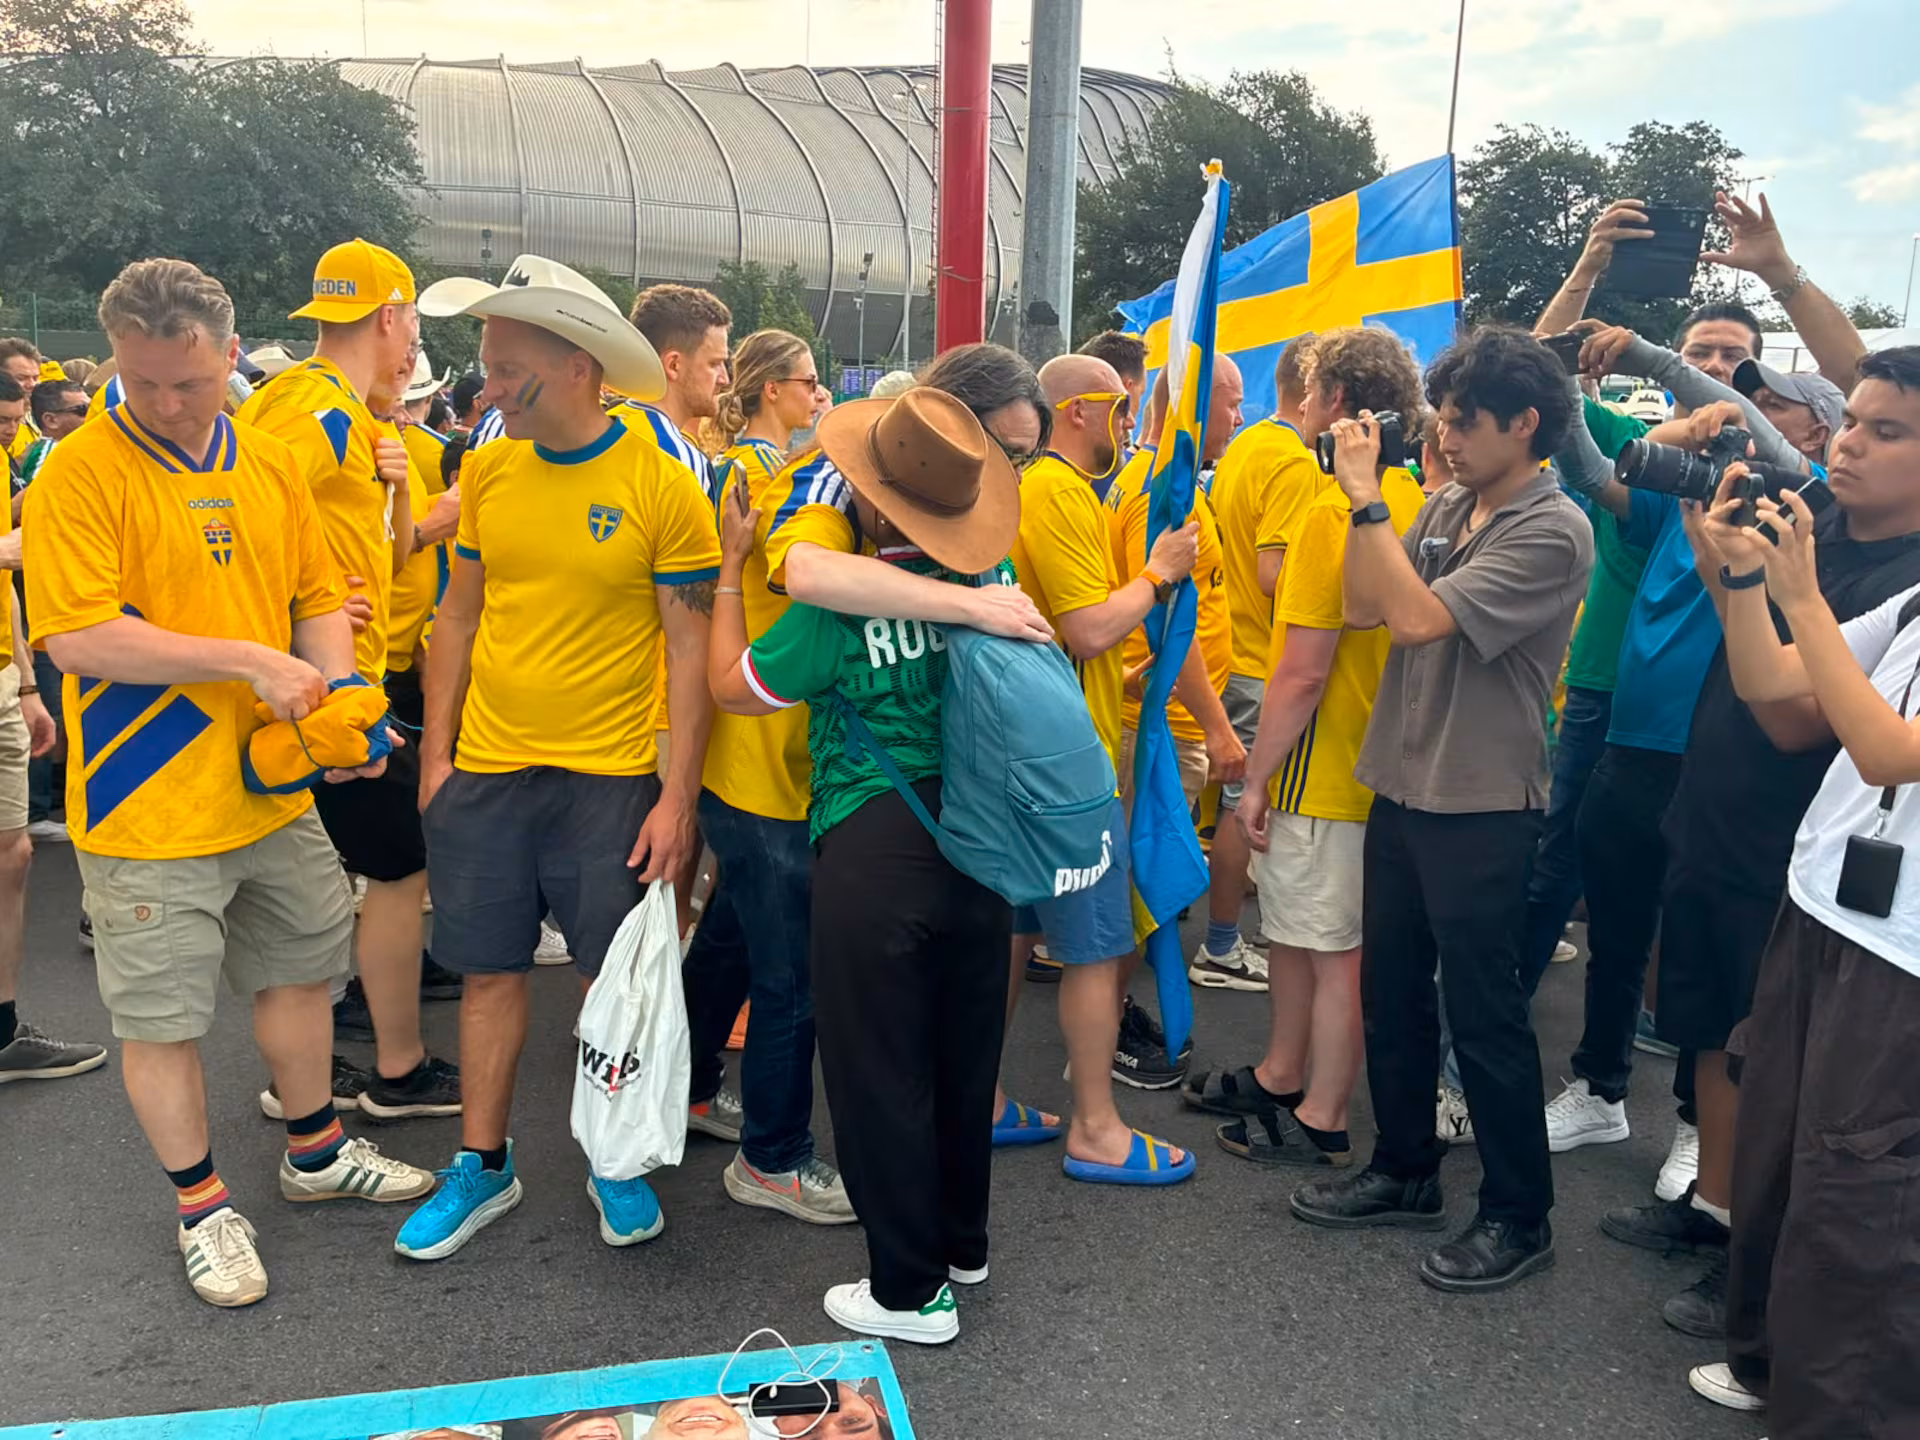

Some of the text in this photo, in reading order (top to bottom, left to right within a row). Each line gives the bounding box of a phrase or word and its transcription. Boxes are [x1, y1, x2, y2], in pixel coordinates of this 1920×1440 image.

[313, 279, 356, 296] WEDEN
[188, 497, 234, 509] adidas
[1114, 1051, 1138, 1069] OKA
